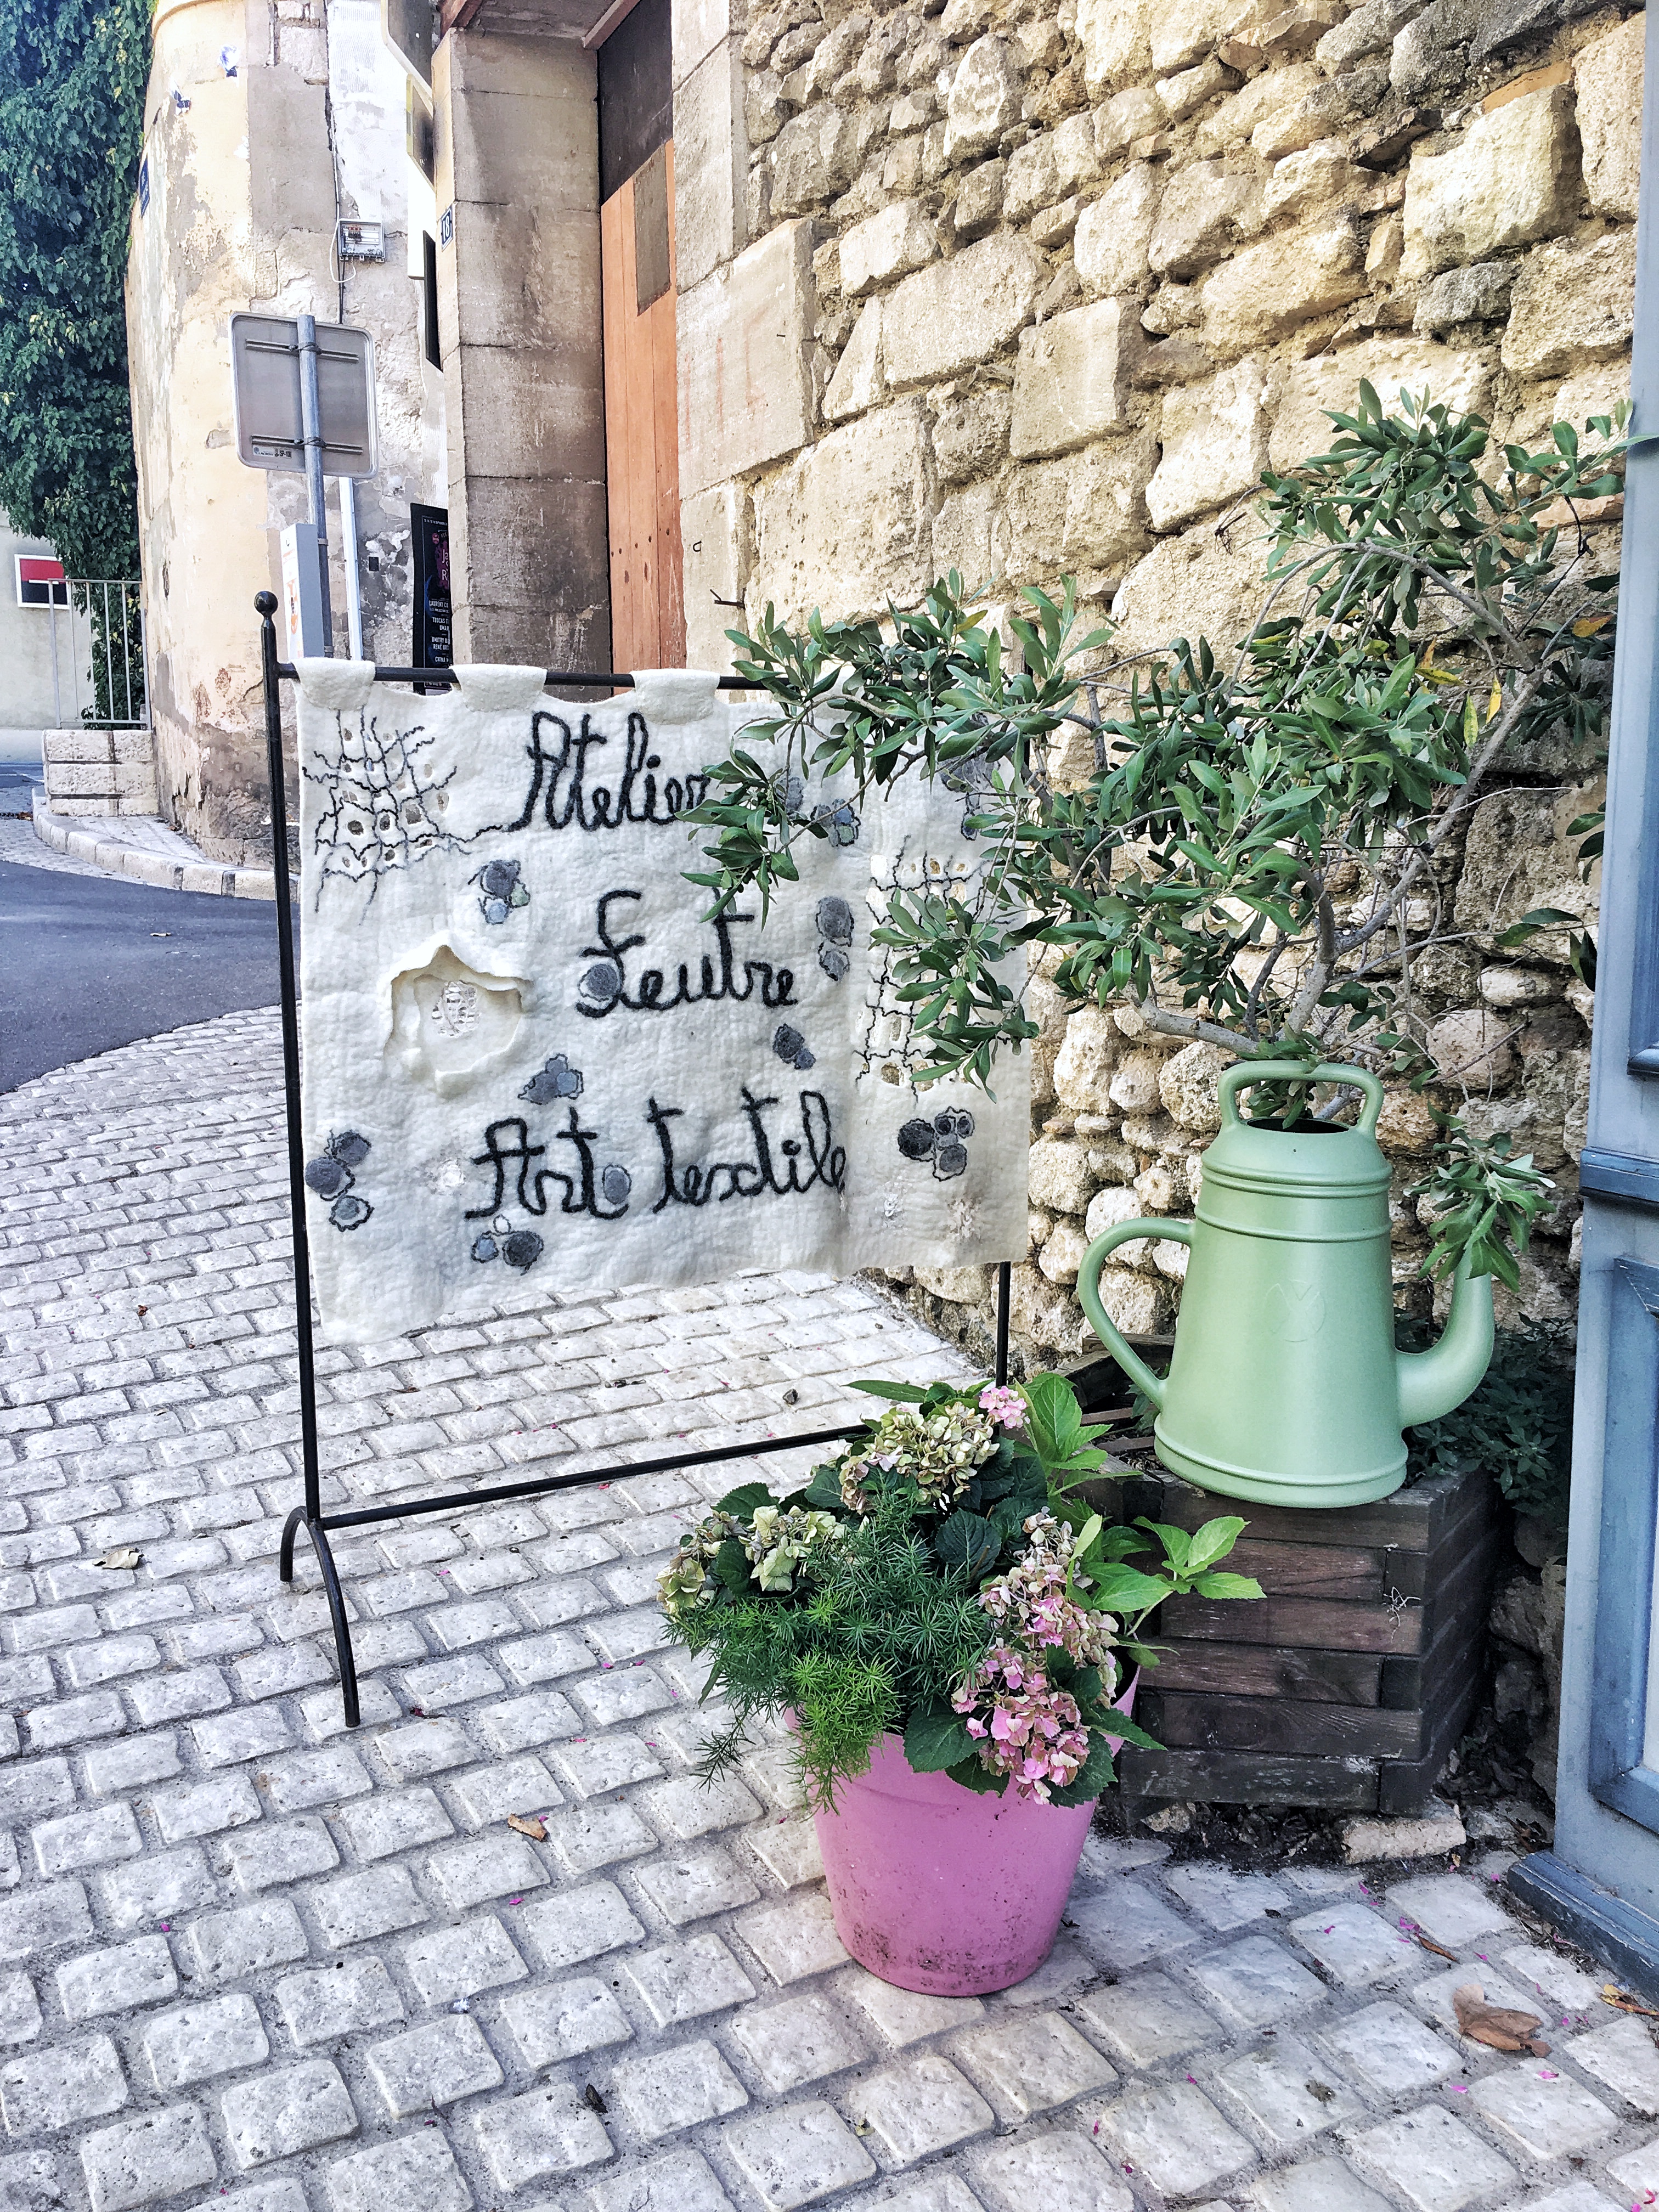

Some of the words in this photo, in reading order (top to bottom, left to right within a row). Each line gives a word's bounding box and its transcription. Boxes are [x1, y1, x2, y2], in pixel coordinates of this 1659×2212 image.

[443, 215, 450, 242] 18
[503, 711, 710, 833] Atelier
[465, 1106, 628, 1221] Art
